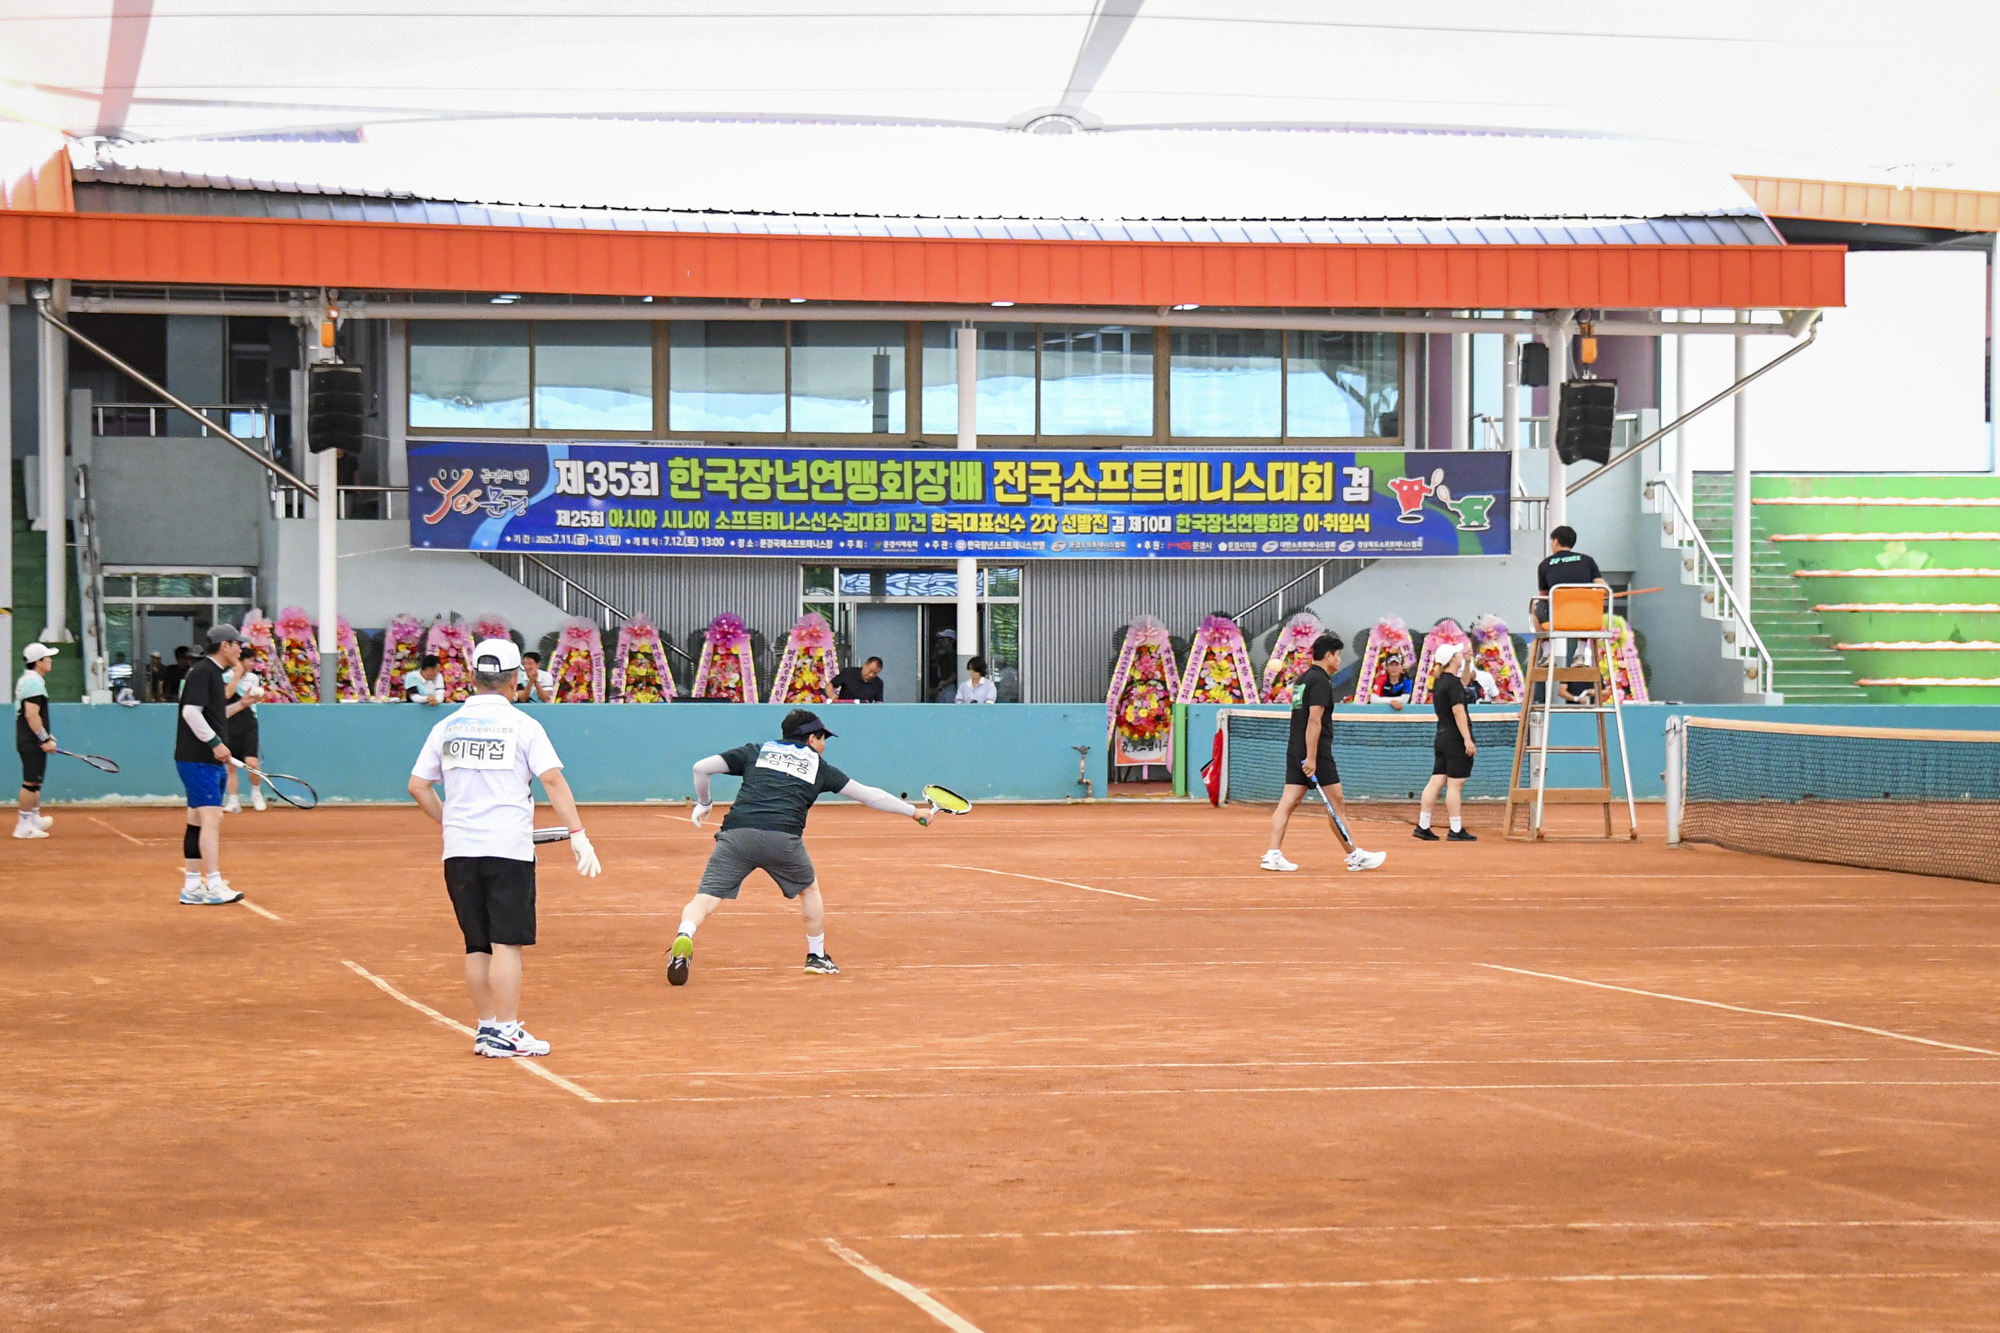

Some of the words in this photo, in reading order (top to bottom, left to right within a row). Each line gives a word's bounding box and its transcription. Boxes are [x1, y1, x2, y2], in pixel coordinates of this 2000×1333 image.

[554, 459, 660, 498] 제35회
[667, 456, 983, 502] 한국장년연맹회장배
[993, 461, 1334, 503] 전국소프트테니스대회
[1342, 466, 1371, 502] 겸
[424, 468, 482, 525] Yes
[479, 486, 529, 519] 문경
[556, 509, 605, 528] 제25회
[608, 509, 658, 529] 아시아
[661, 510, 710, 530] 시니어
[714, 510, 890, 532] 소프트테니스선수권대회
[894, 512, 927, 533] 파견
[931, 512, 1026, 534] 한국대표선수
[1030, 513, 1058, 533] 2차
[1061, 513, 1109, 534] 선발전
[1112, 515, 1125, 534] 겸
[1128, 515, 1172, 533] 제10대
[1176, 513, 1299, 534] 한국장년연맹회장
[701, 537, 725, 547] 13:00
[451, 741, 506, 760] 이태섭
[768, 752, 810, 775] 장수용
